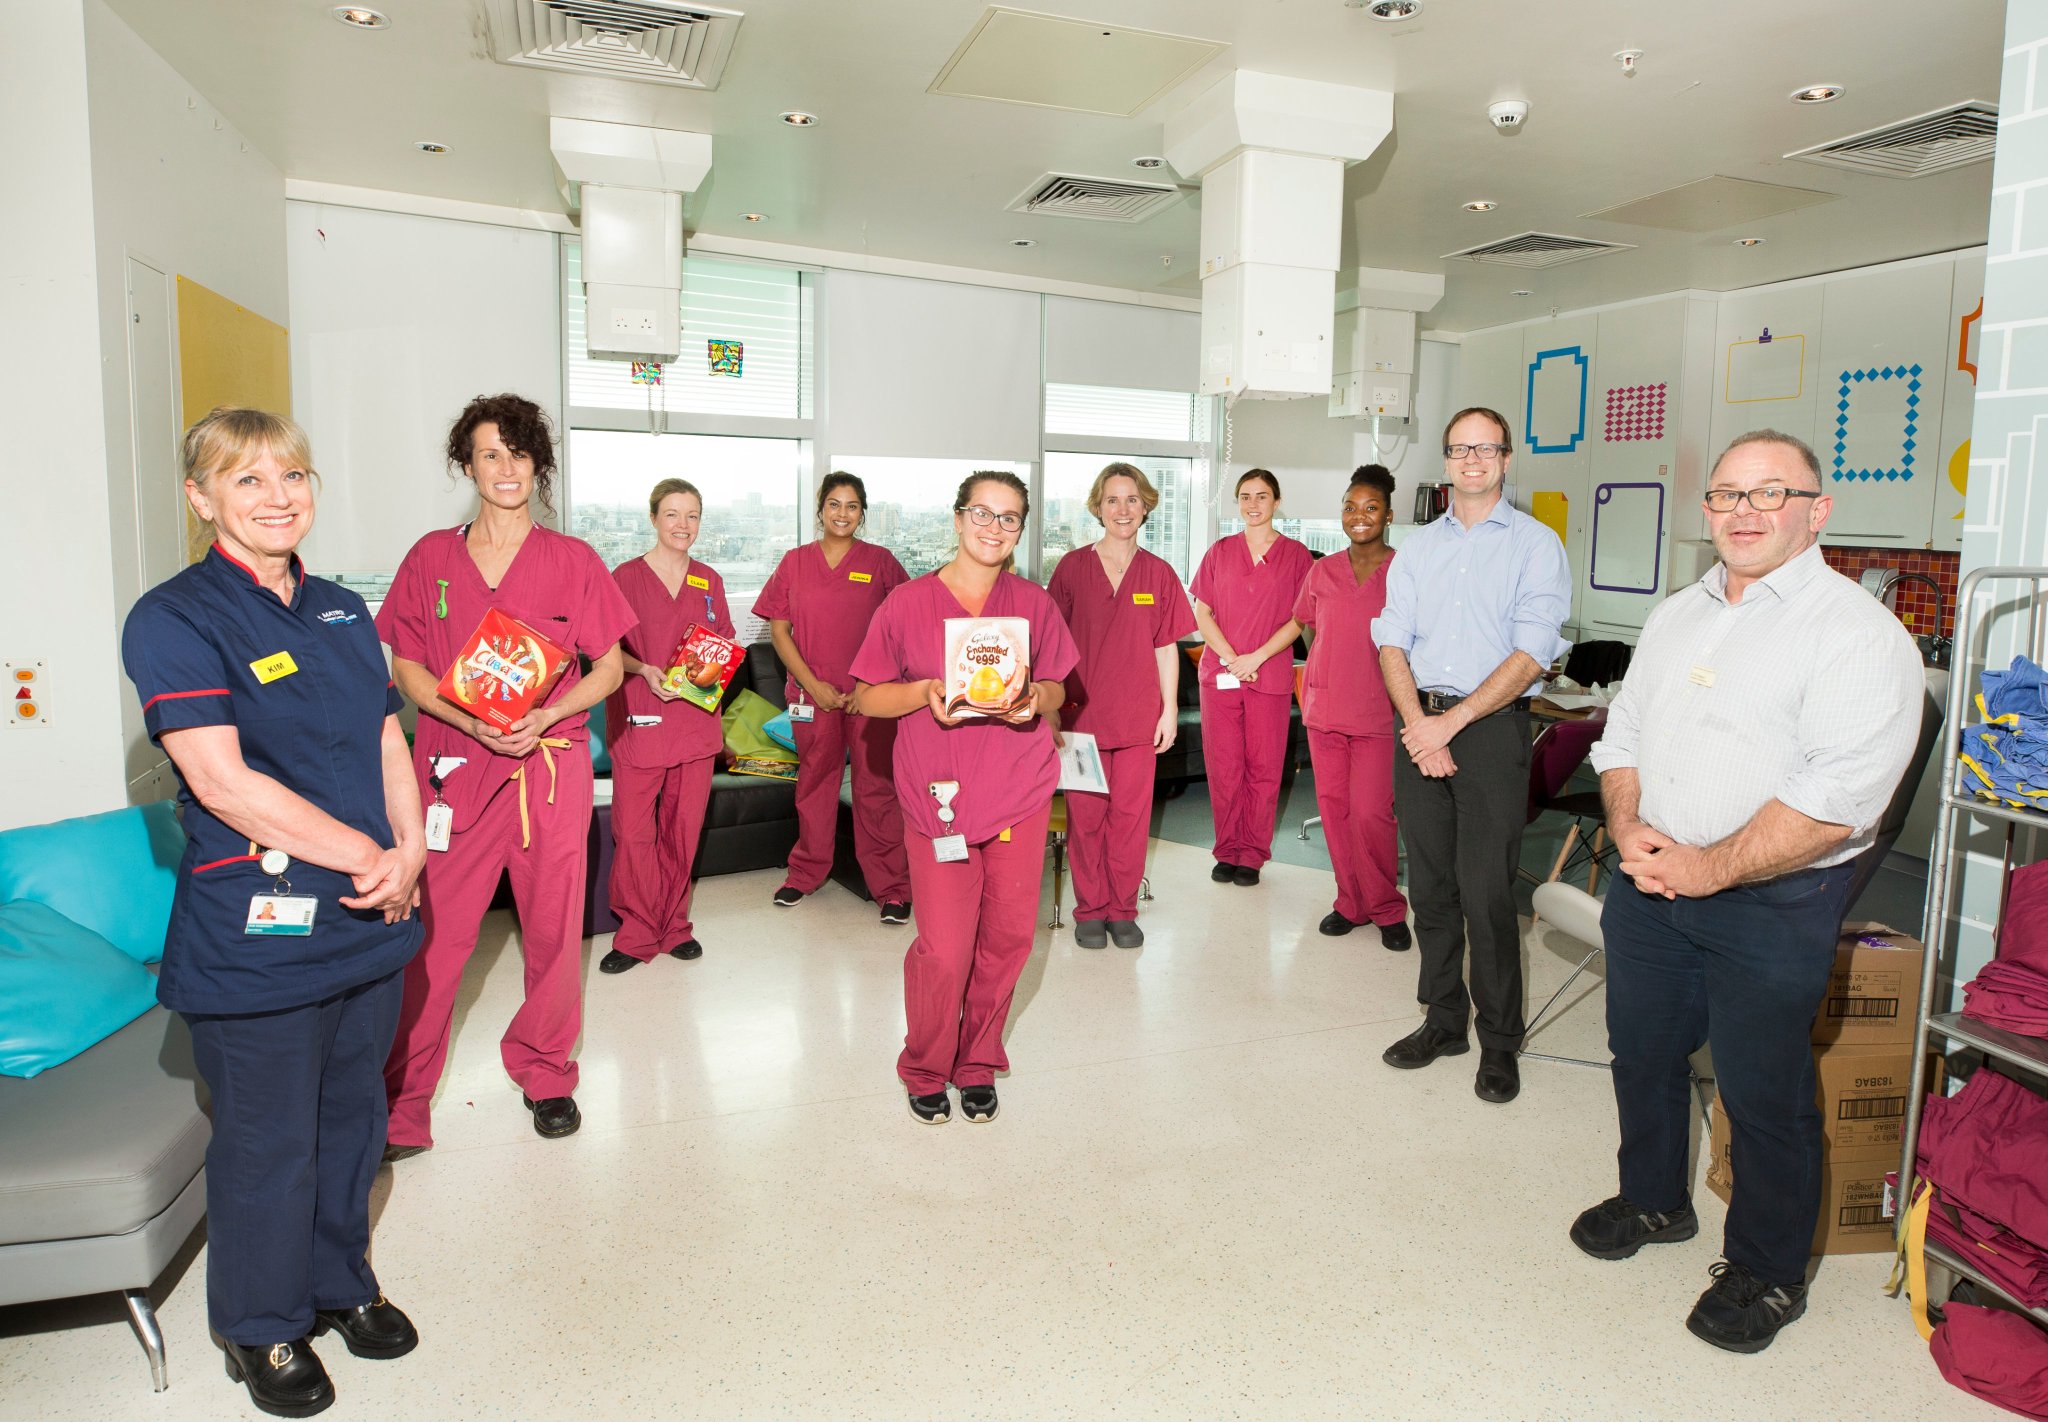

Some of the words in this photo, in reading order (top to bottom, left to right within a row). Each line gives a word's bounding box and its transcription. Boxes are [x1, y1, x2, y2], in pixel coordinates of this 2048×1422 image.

[971, 632, 1000, 644] Galaxy
[698, 642, 730, 664] KitKat
[966, 644, 1009, 661] Enchanted
[975, 653, 1001, 666] eggs
[267, 662, 285, 674] KIM
[1855, 1076, 1893, 1088] 183BAG
